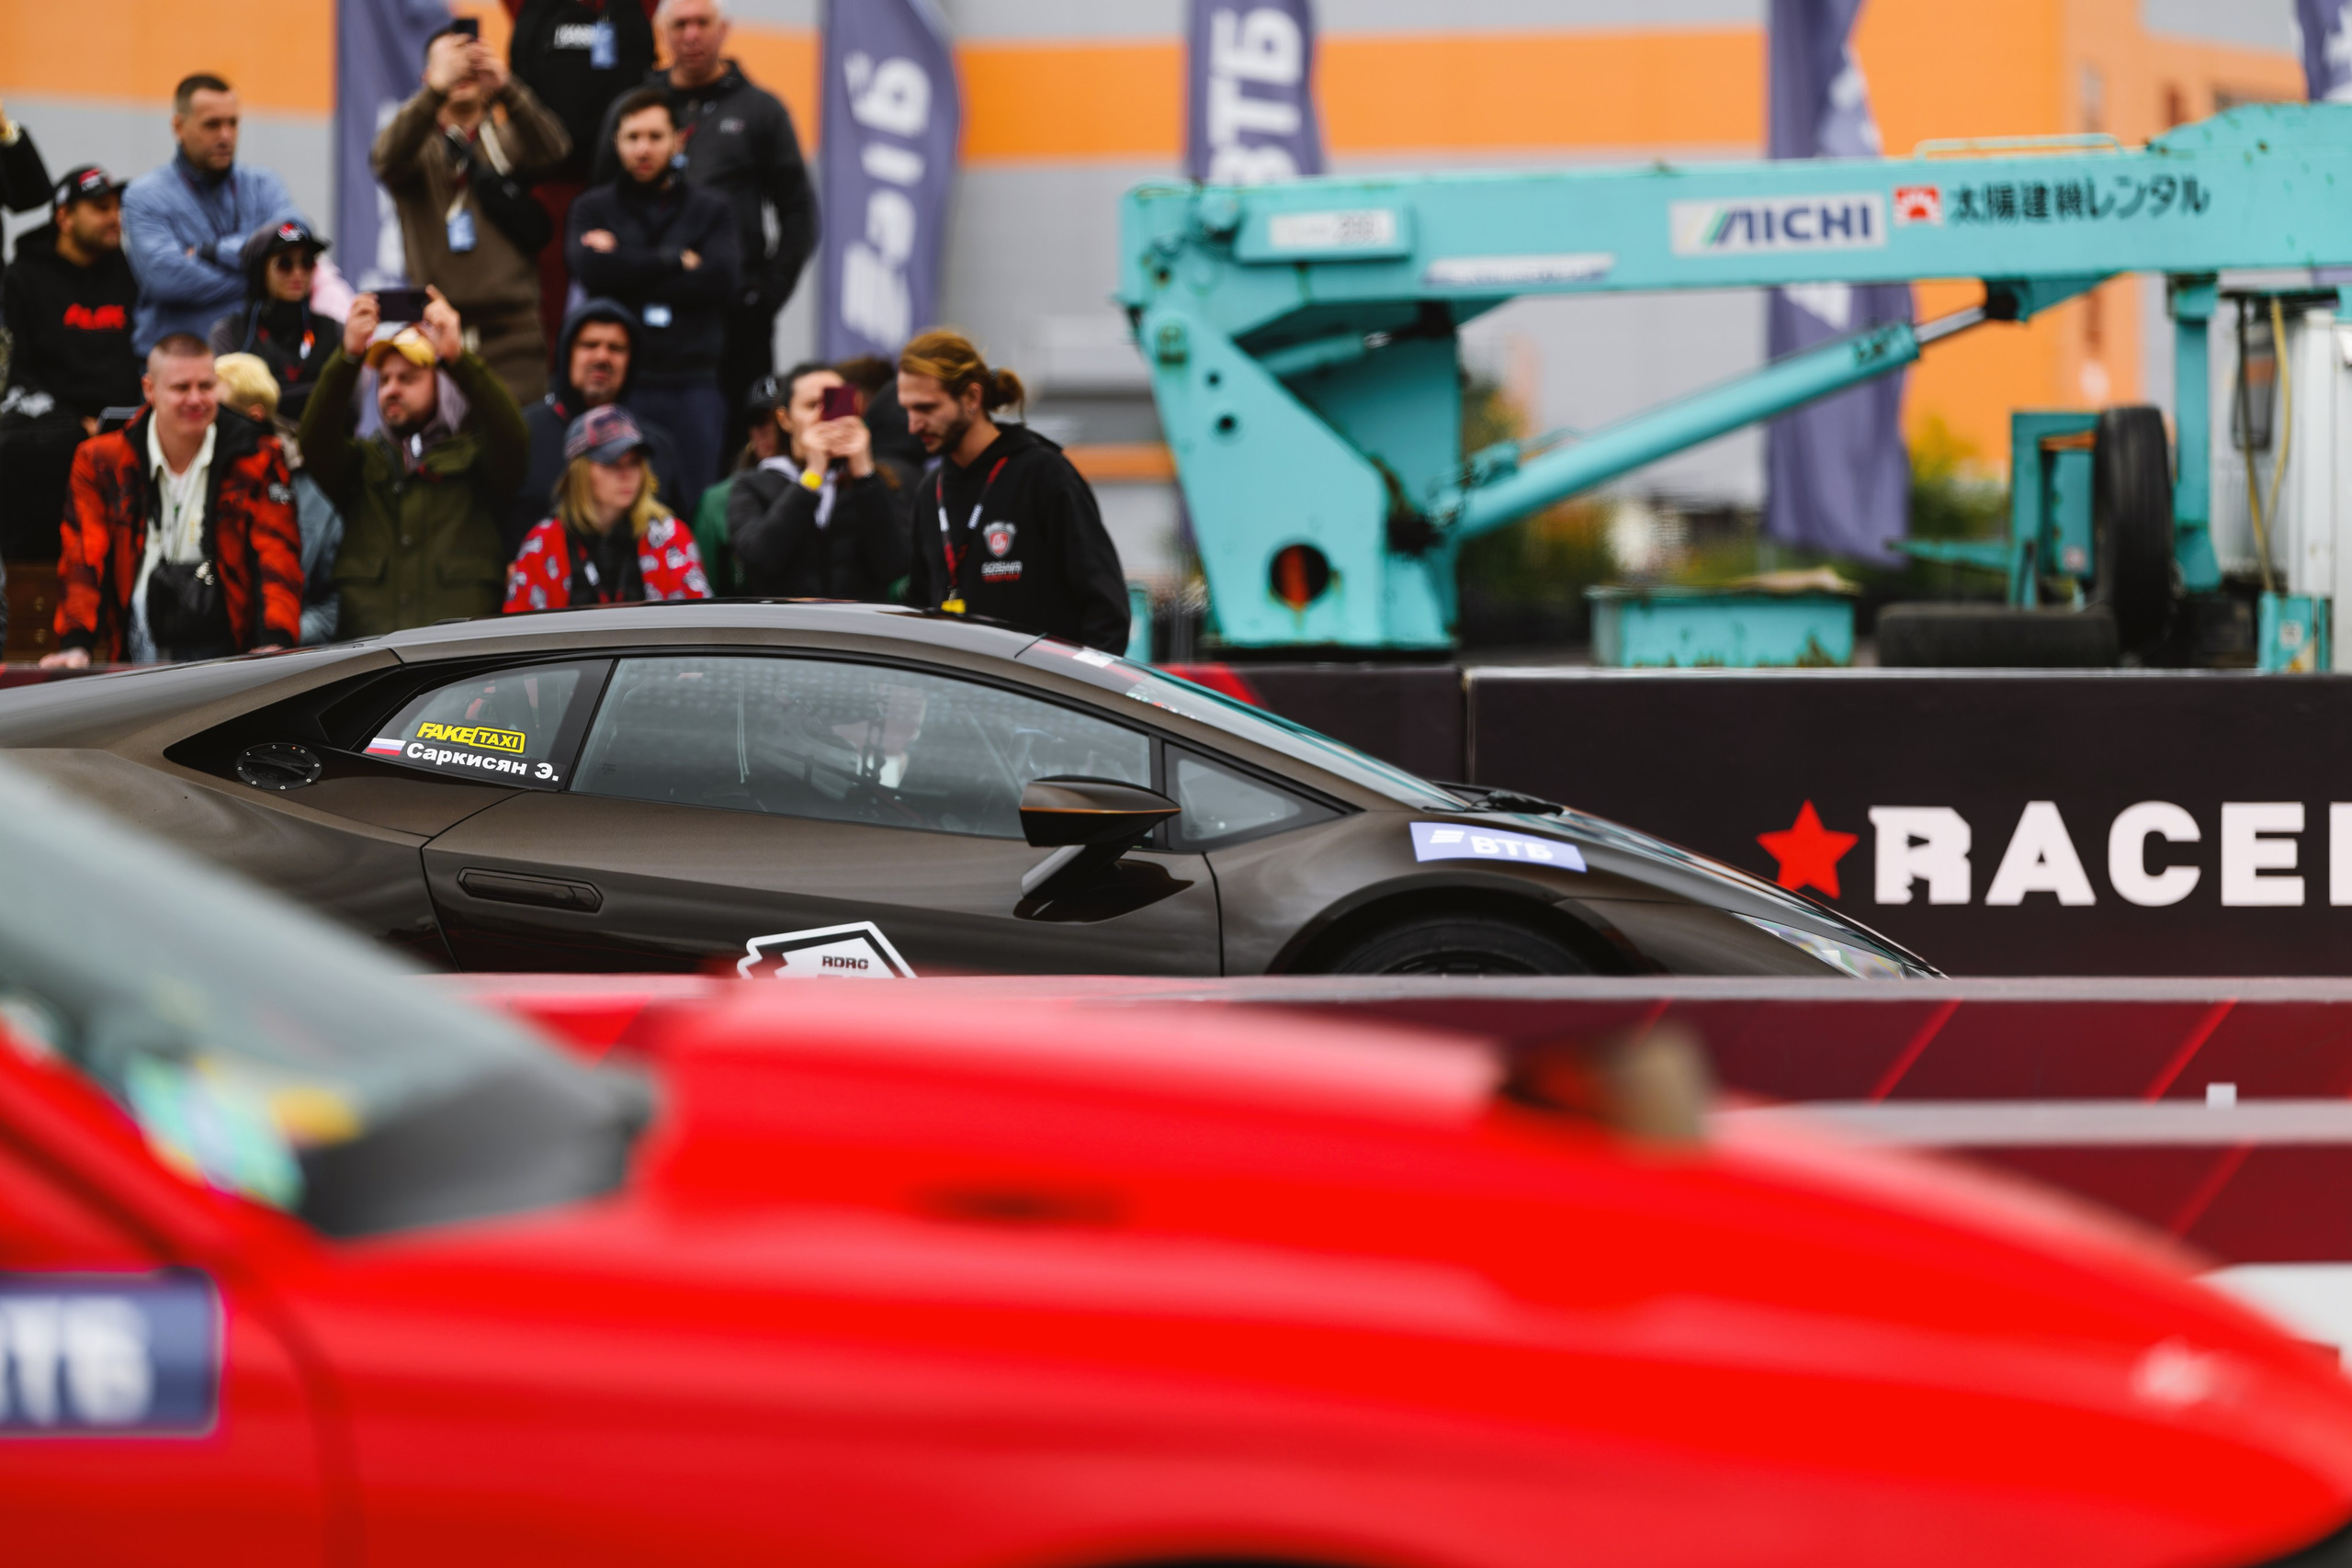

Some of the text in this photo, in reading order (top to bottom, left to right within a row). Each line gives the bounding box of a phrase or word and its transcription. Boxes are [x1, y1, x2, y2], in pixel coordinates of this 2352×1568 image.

[1711, 203, 1872, 246] AICHI
[416, 722, 520, 750] FAKE TAXI
[406, 742, 560, 782] Саркисян Э.
[1470, 835, 1554, 861] ВТБ
[1868, 799, 2352, 908] RACE
[0, 1295, 154, 1426] ТБ
